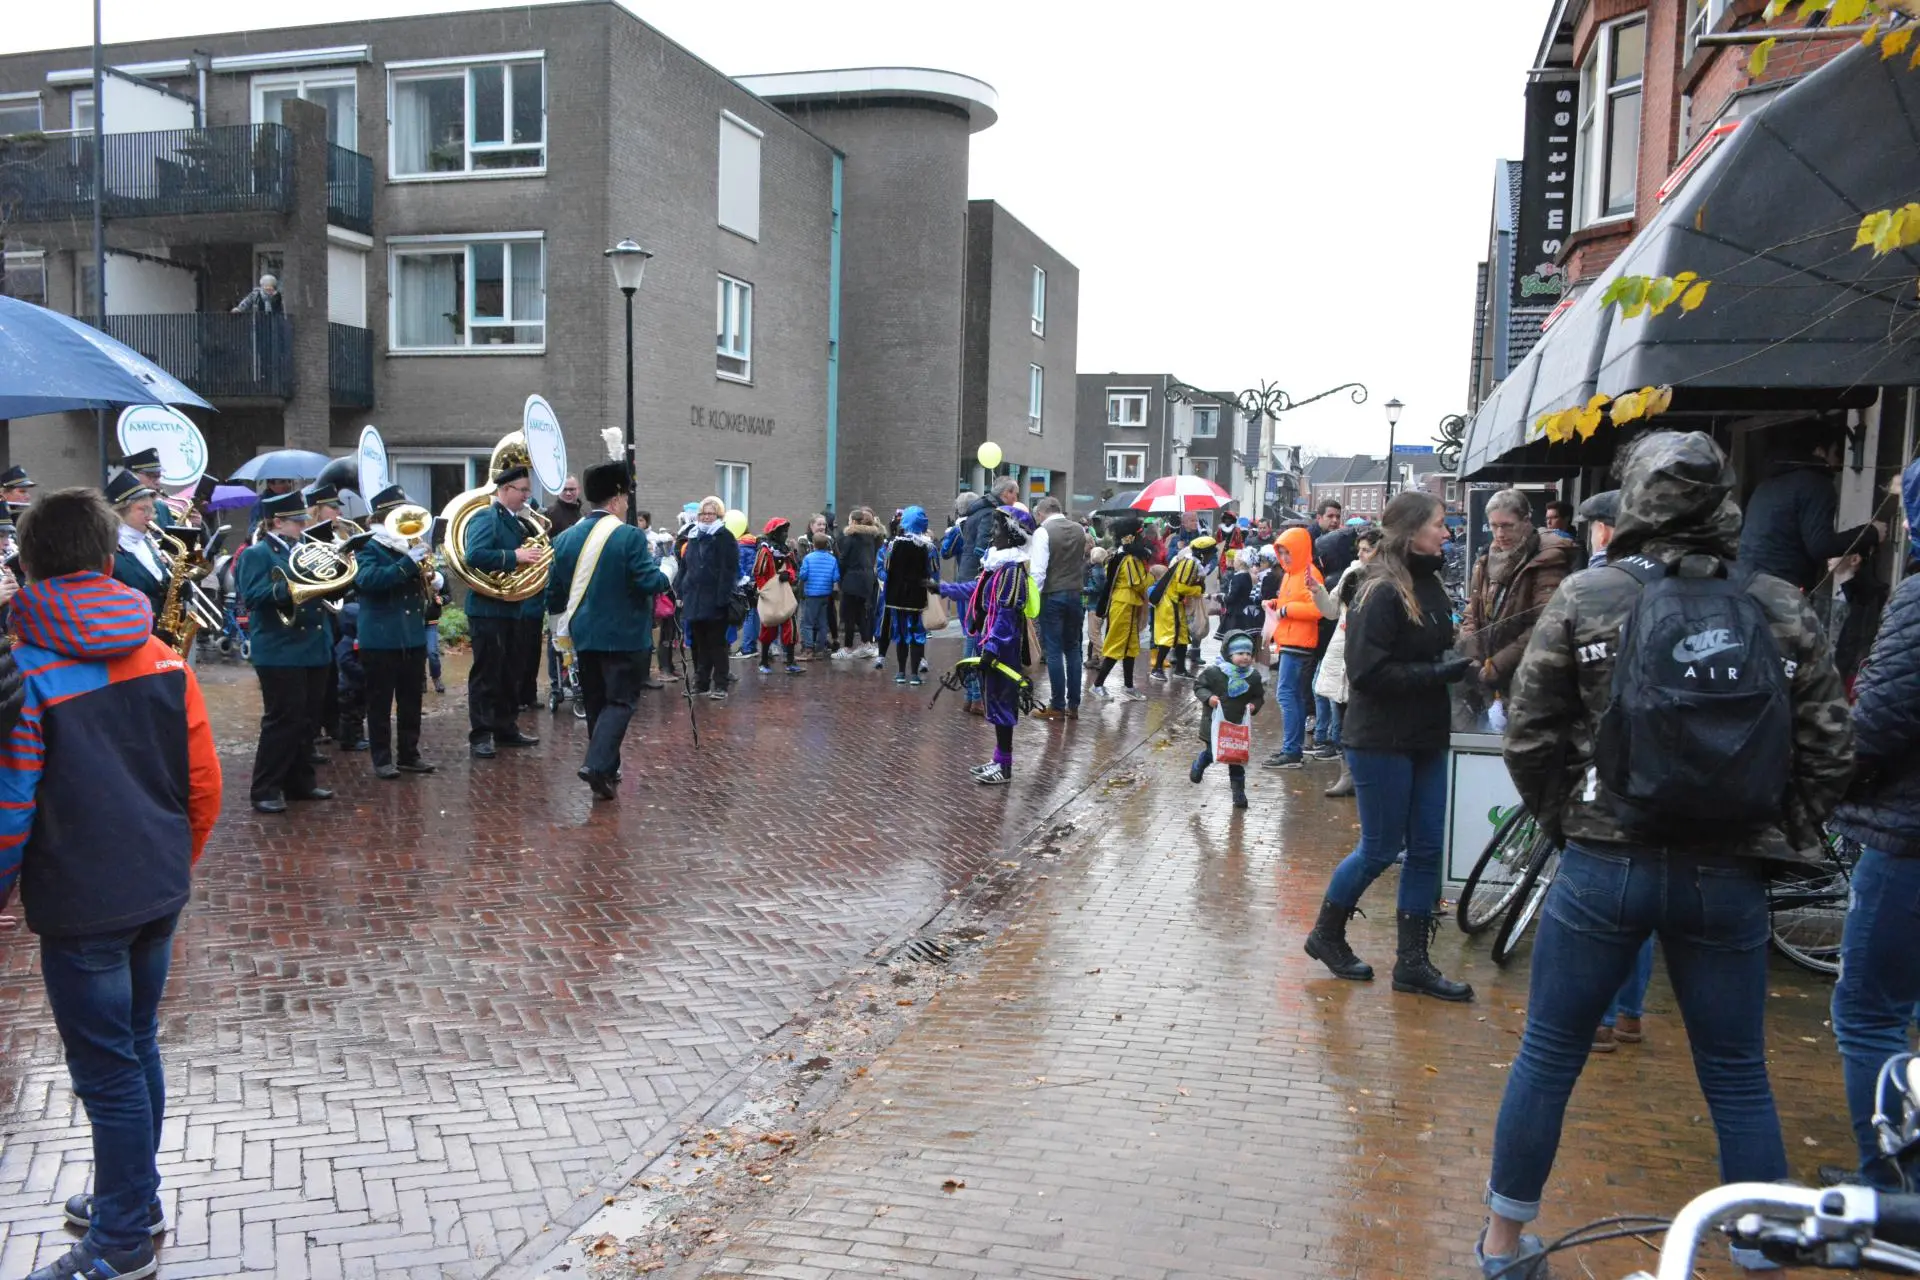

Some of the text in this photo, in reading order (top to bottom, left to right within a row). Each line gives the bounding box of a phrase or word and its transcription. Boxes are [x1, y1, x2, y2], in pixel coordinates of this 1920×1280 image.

[1542, 89, 1571, 255] smitties
[129, 422, 184, 433] AMICITIA
[691, 405, 704, 428] DE
[1684, 628, 1730, 651] NIKE
[1683, 666, 1738, 680] AIR
